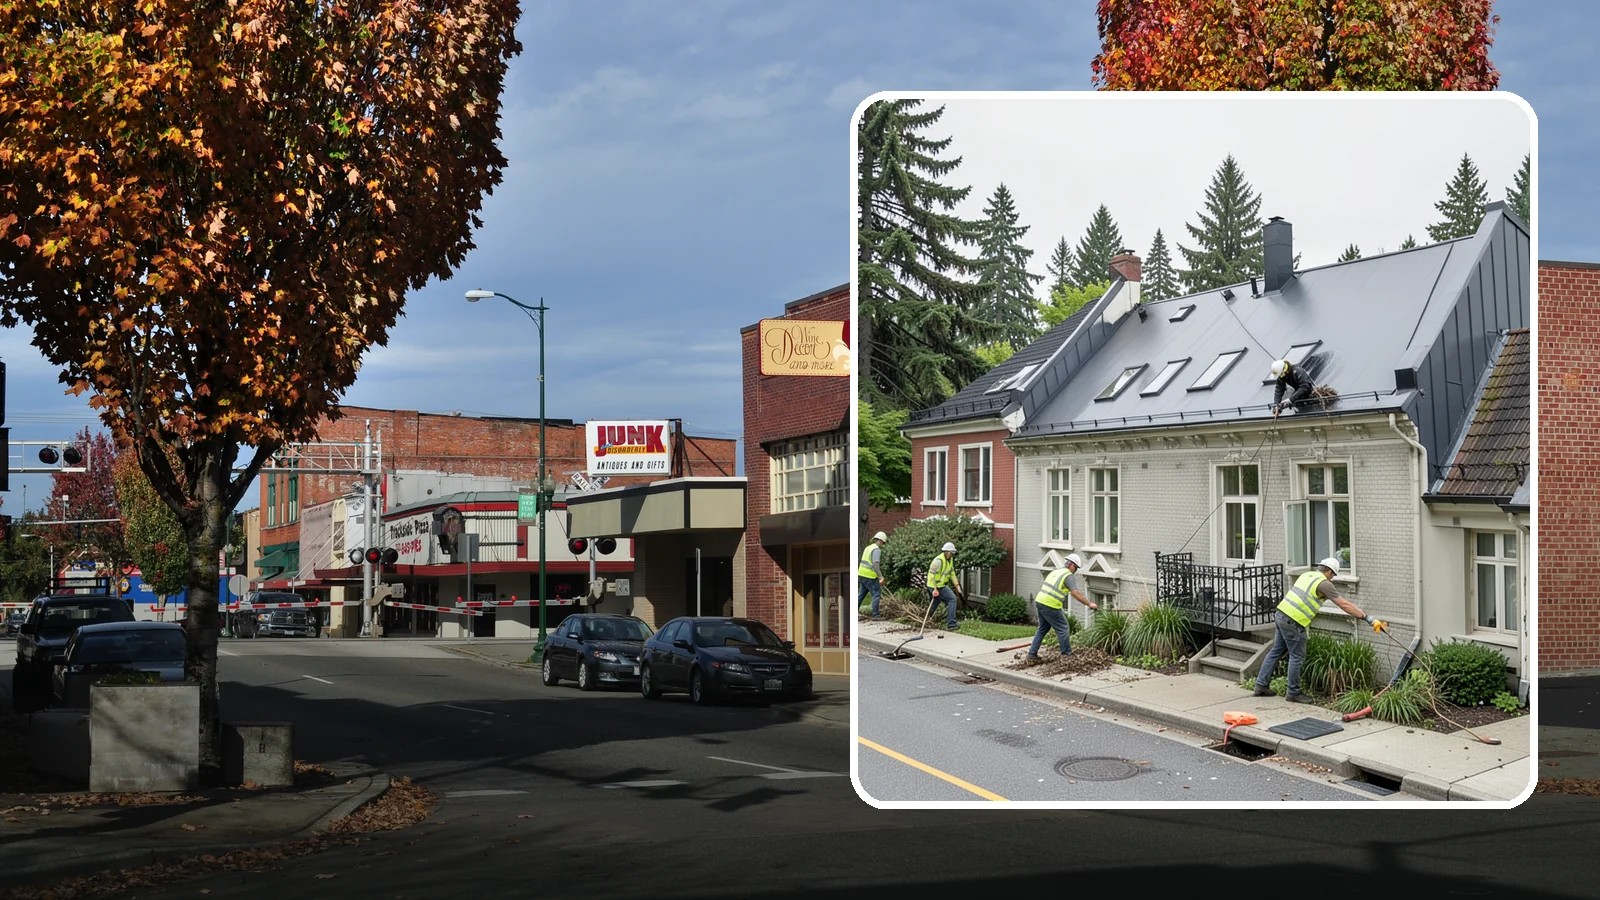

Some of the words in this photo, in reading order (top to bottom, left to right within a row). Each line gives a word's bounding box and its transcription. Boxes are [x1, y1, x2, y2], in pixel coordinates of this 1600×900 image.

[595, 425, 665, 457] JUNK
[607, 446, 646, 454] DISORDERLY
[597, 461, 628, 470] ANTIQUES
[631, 461, 644, 470] AND
[647, 460, 665, 469] GIFTS
[573, 473, 590, 492] RAIL
